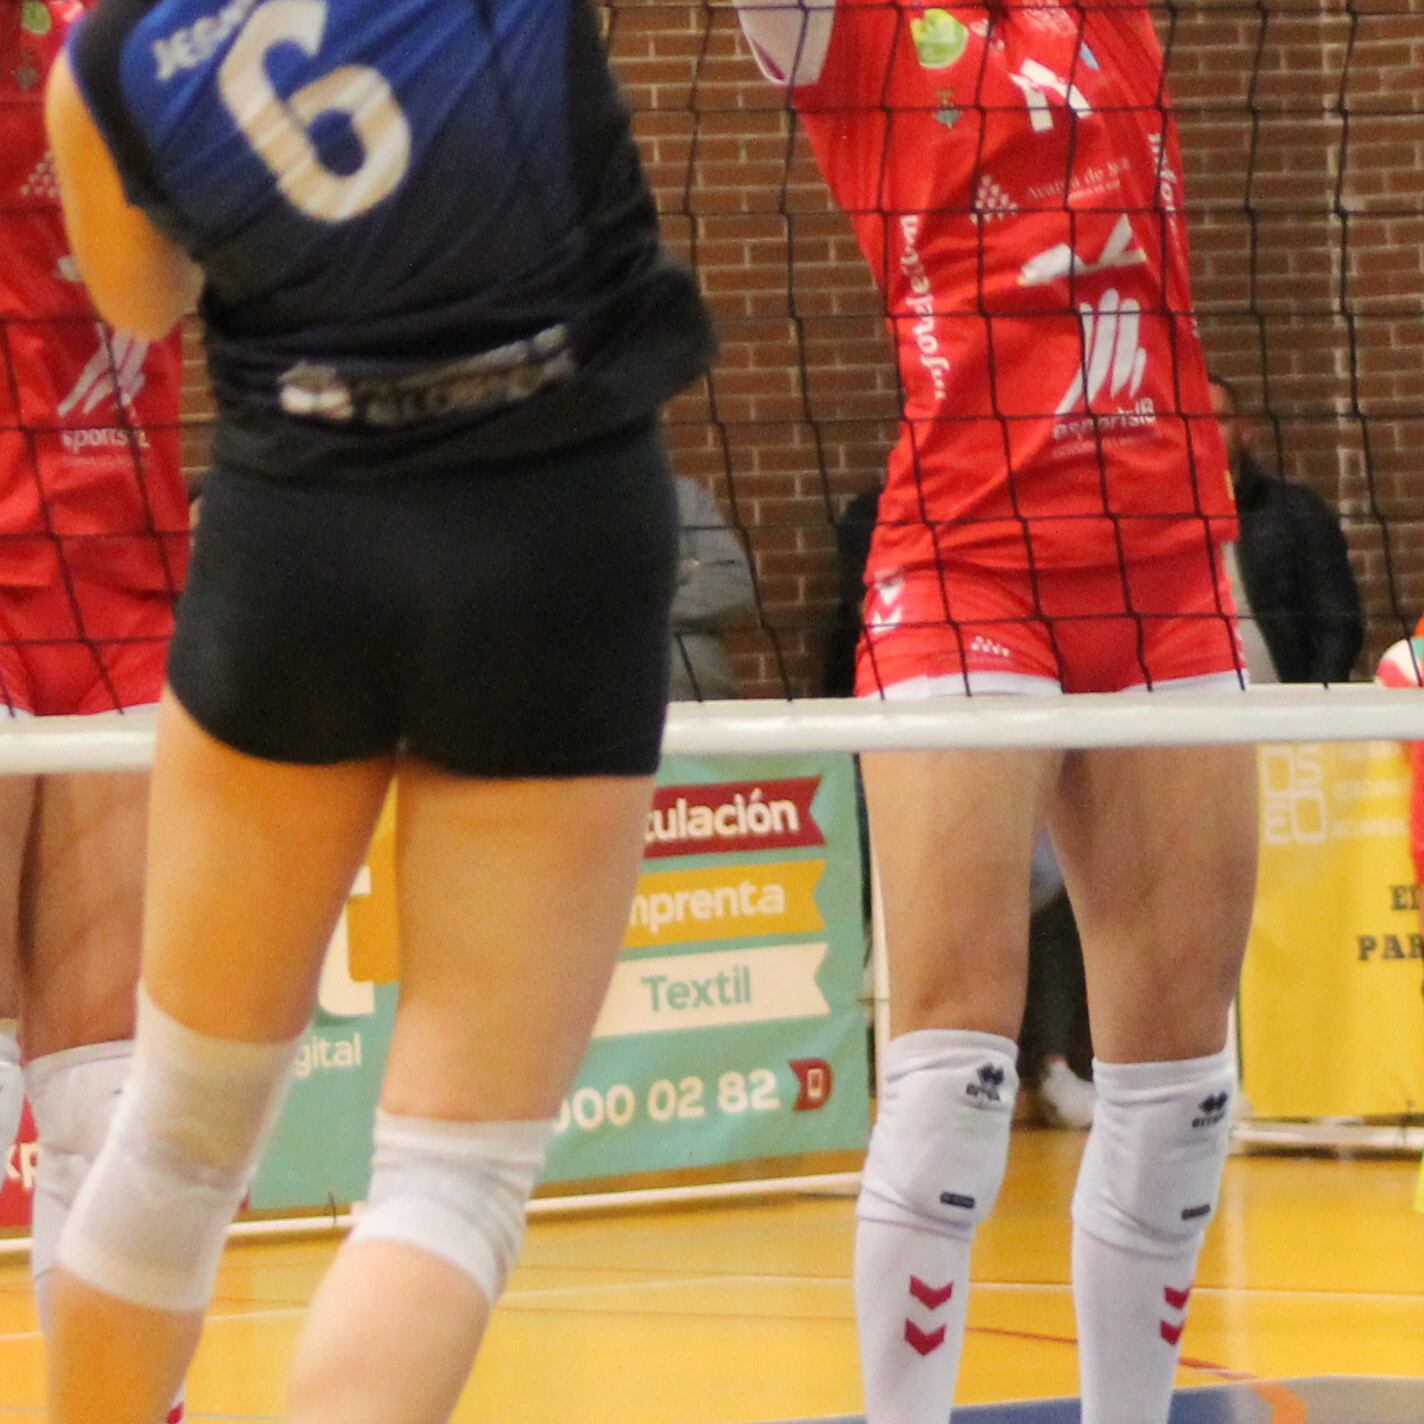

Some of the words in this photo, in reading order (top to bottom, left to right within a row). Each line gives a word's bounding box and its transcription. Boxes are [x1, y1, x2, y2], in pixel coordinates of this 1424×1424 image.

[640, 964, 752, 1013] Textil
[647, 1075, 706, 1122] 02
[717, 1068, 780, 1115] 82
